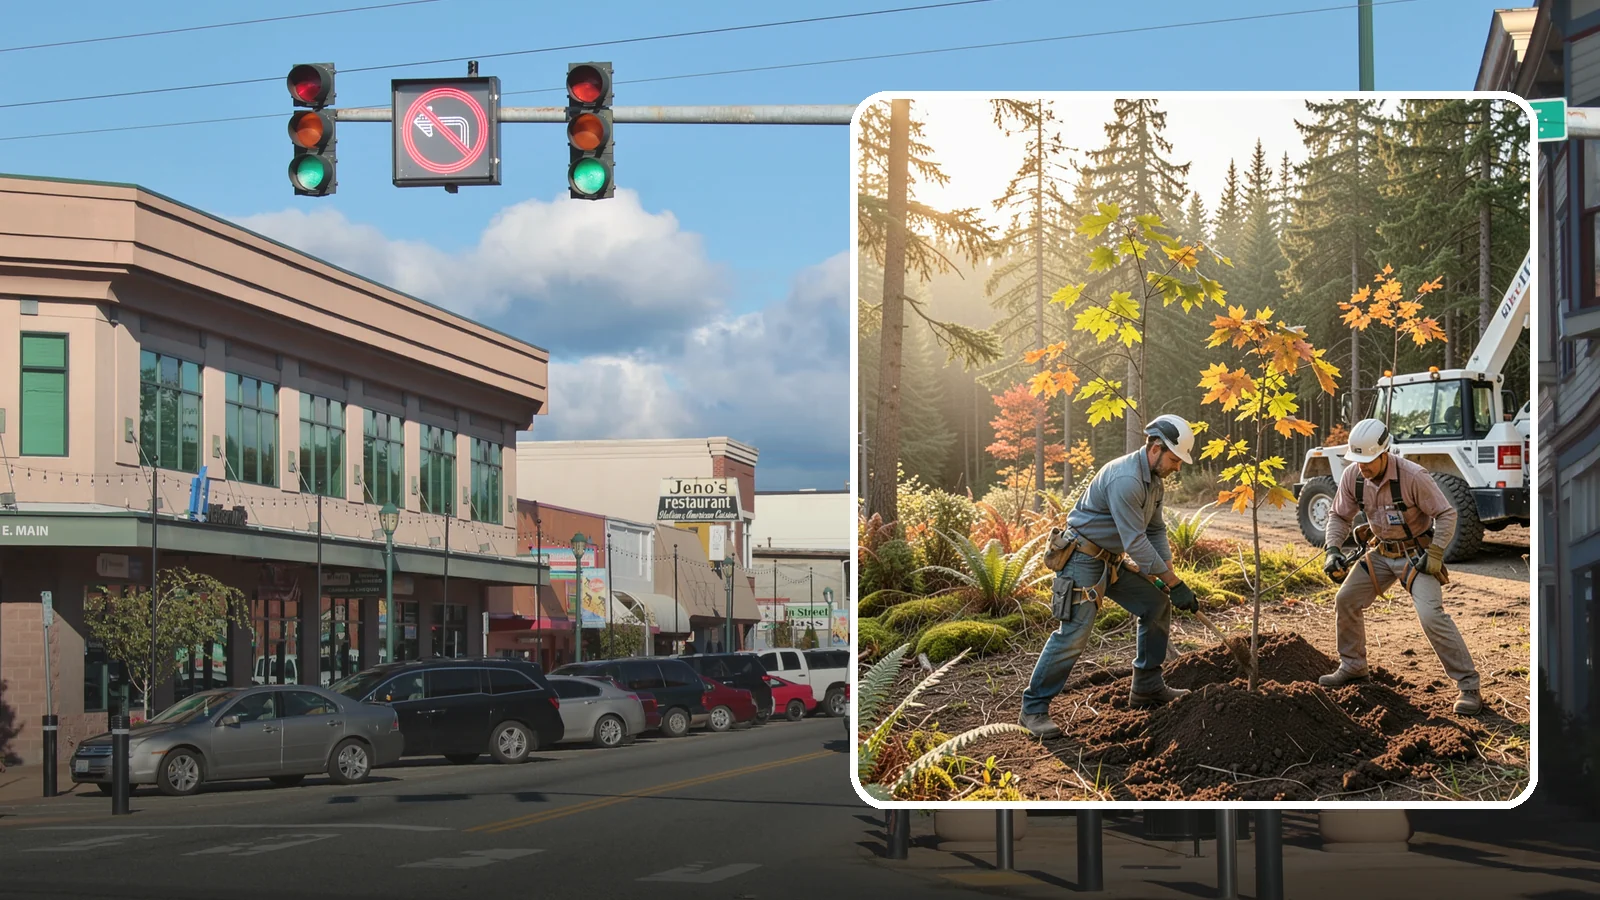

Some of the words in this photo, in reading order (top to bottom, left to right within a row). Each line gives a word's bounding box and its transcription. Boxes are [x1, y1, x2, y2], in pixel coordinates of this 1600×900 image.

[669, 480, 728, 494] Jeno's
[665, 496, 731, 509] restaurant
[658, 510, 681, 519] Italian
[686, 510, 714, 519] American
[715, 509, 738, 519] Cuisine
[2, 525, 13, 536] E.
[15, 525, 49, 536] MAIN
[797, 607, 828, 617] Street
[791, 619, 824, 627] lass
